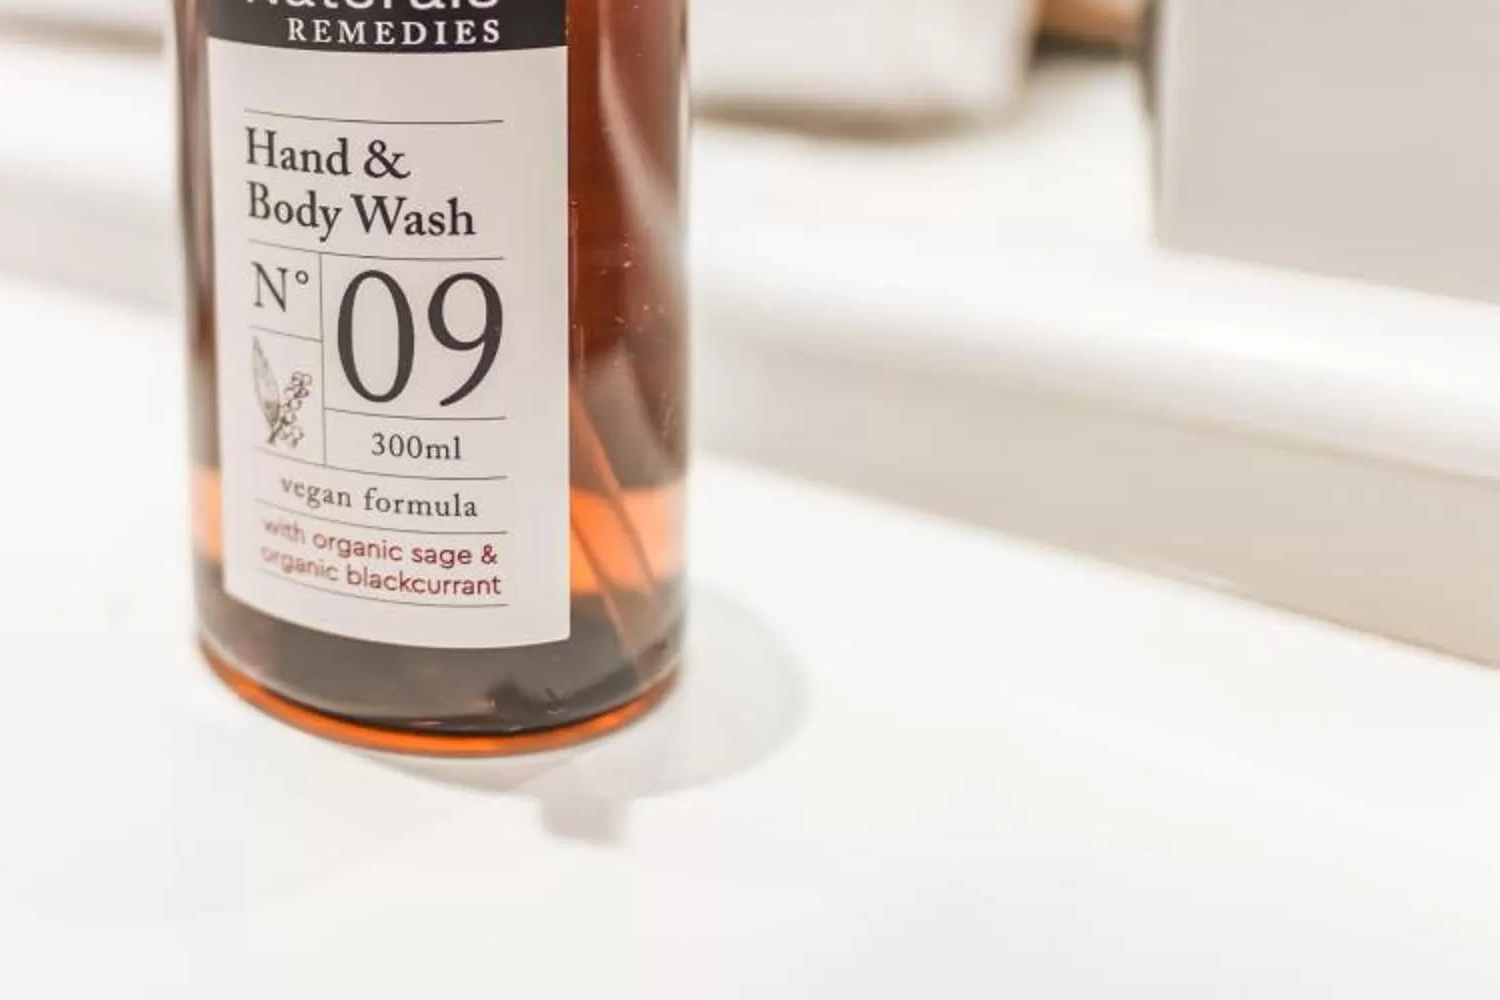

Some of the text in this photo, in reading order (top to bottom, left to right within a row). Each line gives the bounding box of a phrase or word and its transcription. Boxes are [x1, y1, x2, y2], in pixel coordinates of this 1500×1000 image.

[287, 17, 501, 46] REMEDIES
[245, 126, 411, 179] Hand &
[247, 180, 476, 242] Body Wash
[337, 269, 503, 407] 09
[371, 433, 462, 461] 300ml
[280, 477, 478, 517] vegan formula
[262, 517, 498, 569] with organic sage &
[260, 546, 501, 596] organic blackcurrant
